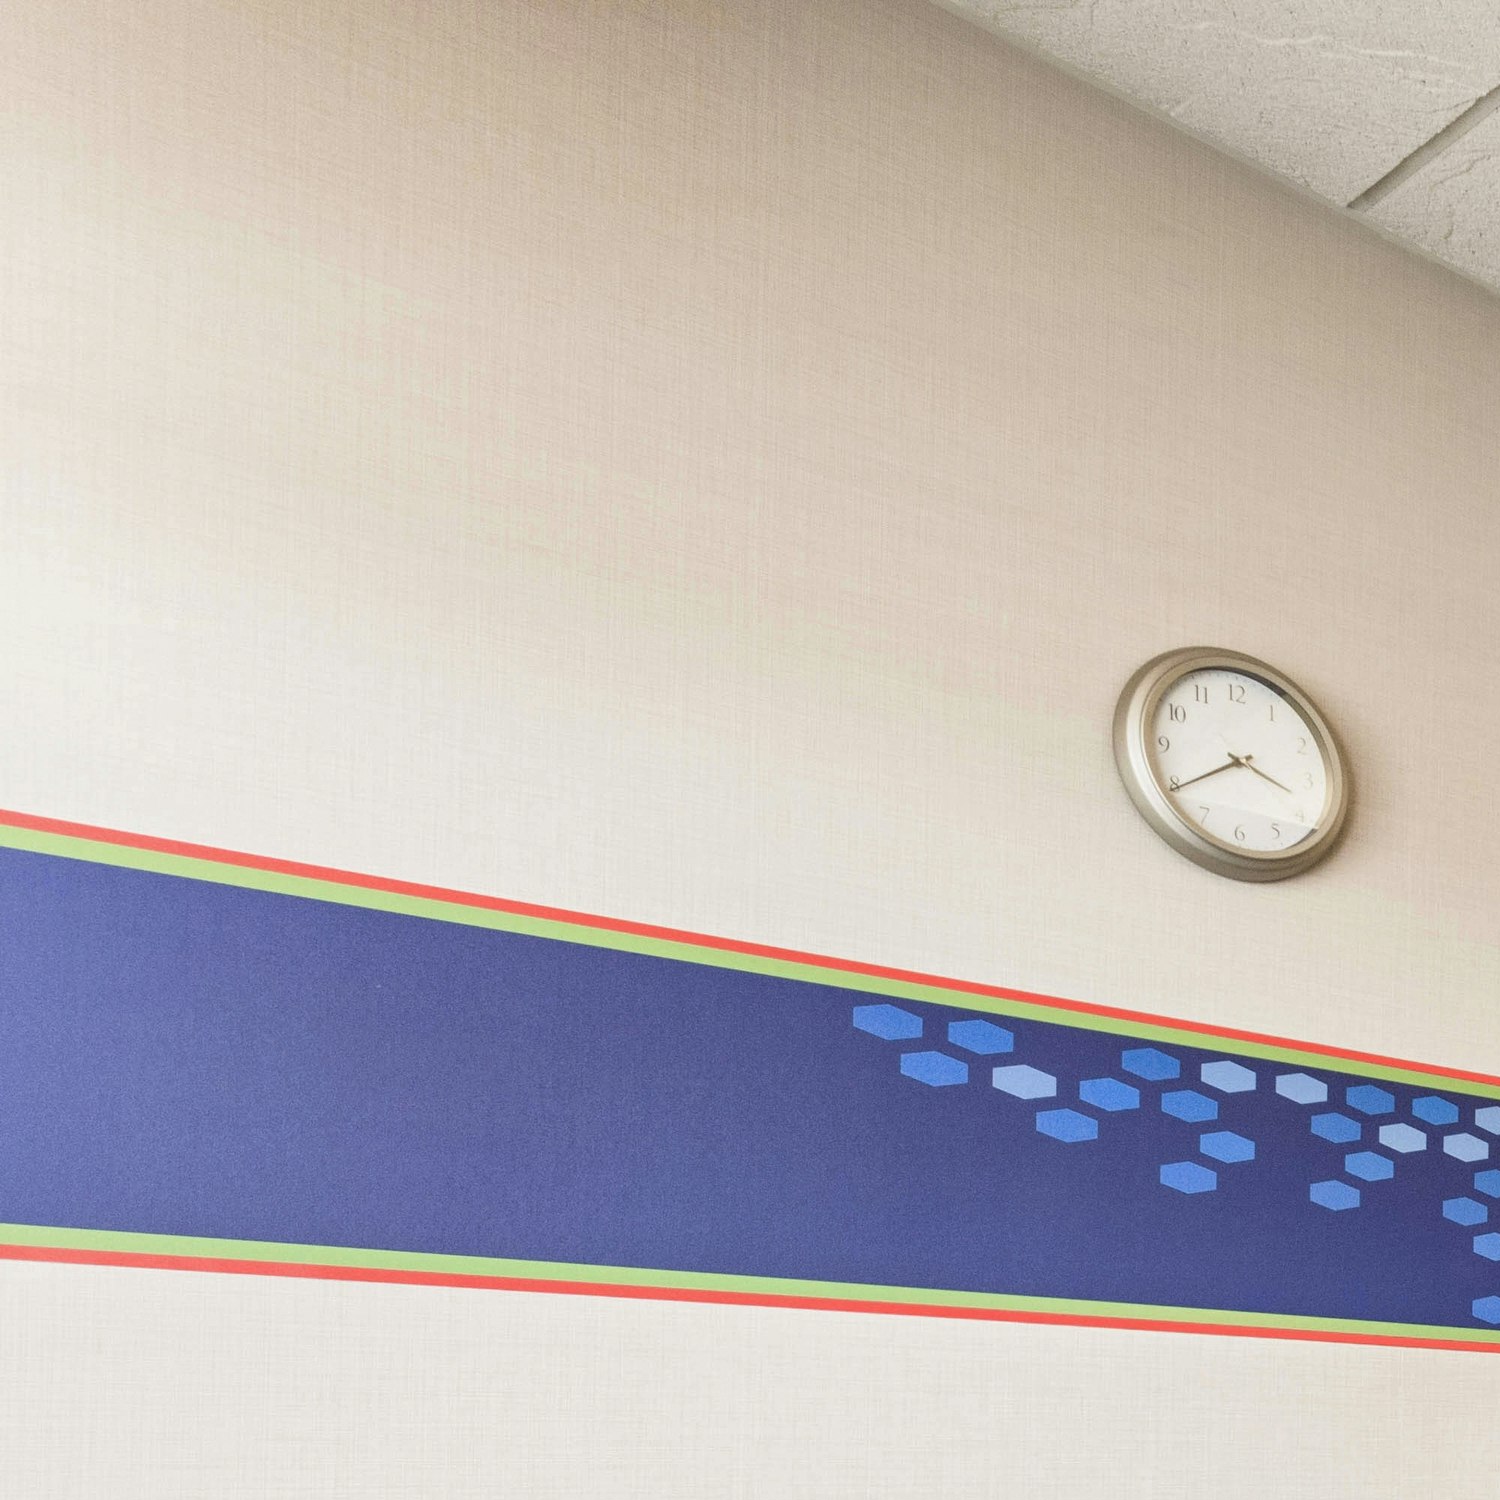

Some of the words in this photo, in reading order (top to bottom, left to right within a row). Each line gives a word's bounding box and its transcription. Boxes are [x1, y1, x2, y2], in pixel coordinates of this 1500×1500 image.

[1194, 684, 1210, 704] 11
[1229, 683, 1247, 705] 12
[1169, 703, 1187, 723] 10
[1268, 705, 1276, 722] 1
[1158, 736, 1170, 753] 9
[1297, 737, 1307, 755] 2
[1170, 776, 1181, 793] 8
[1304, 772, 1314, 790] 3
[1199, 806, 1210, 825] 7
[1234, 825, 1246, 841] 6
[1271, 823, 1281, 839] 5
